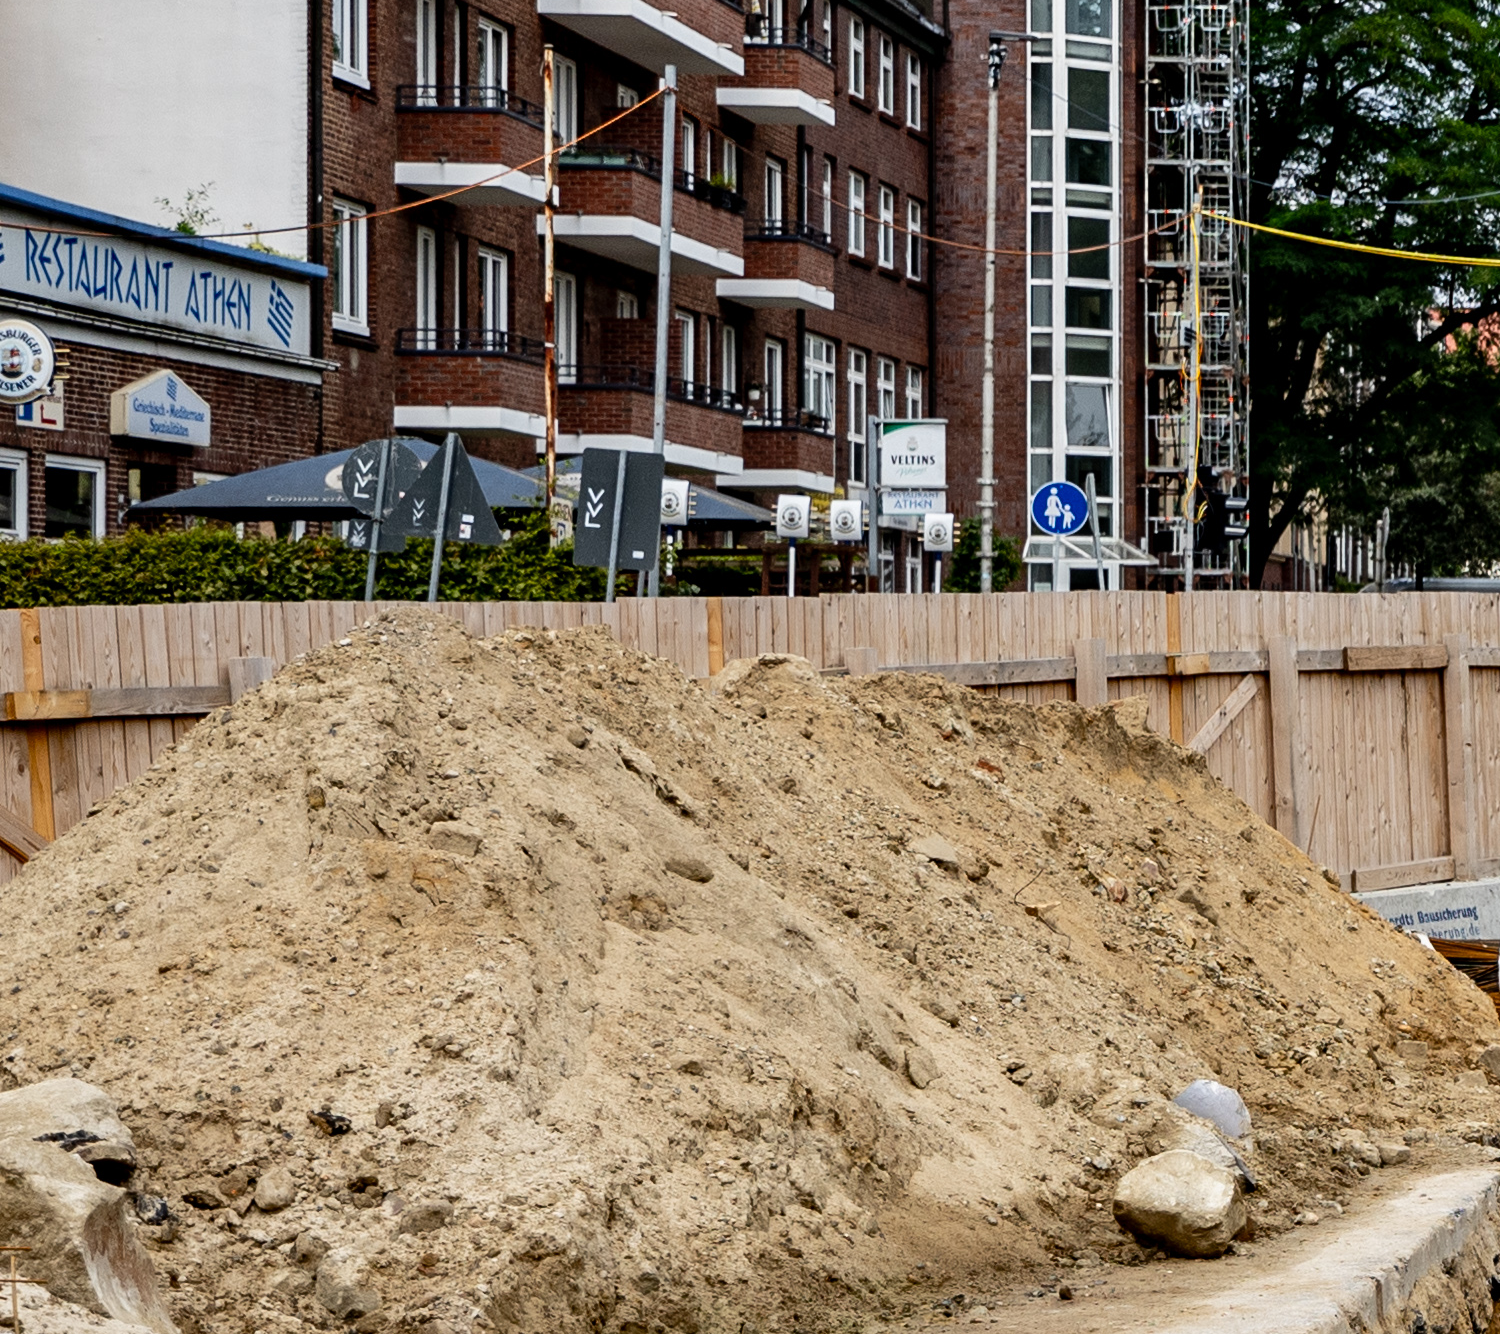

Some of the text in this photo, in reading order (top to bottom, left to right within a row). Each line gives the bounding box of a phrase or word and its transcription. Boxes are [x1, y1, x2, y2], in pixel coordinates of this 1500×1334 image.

[24, 227, 252, 331] RESTAURANT ATHEN
[890, 455, 935, 465] VELTINS
[1387, 906, 1479, 926] ordts Bausicherung
